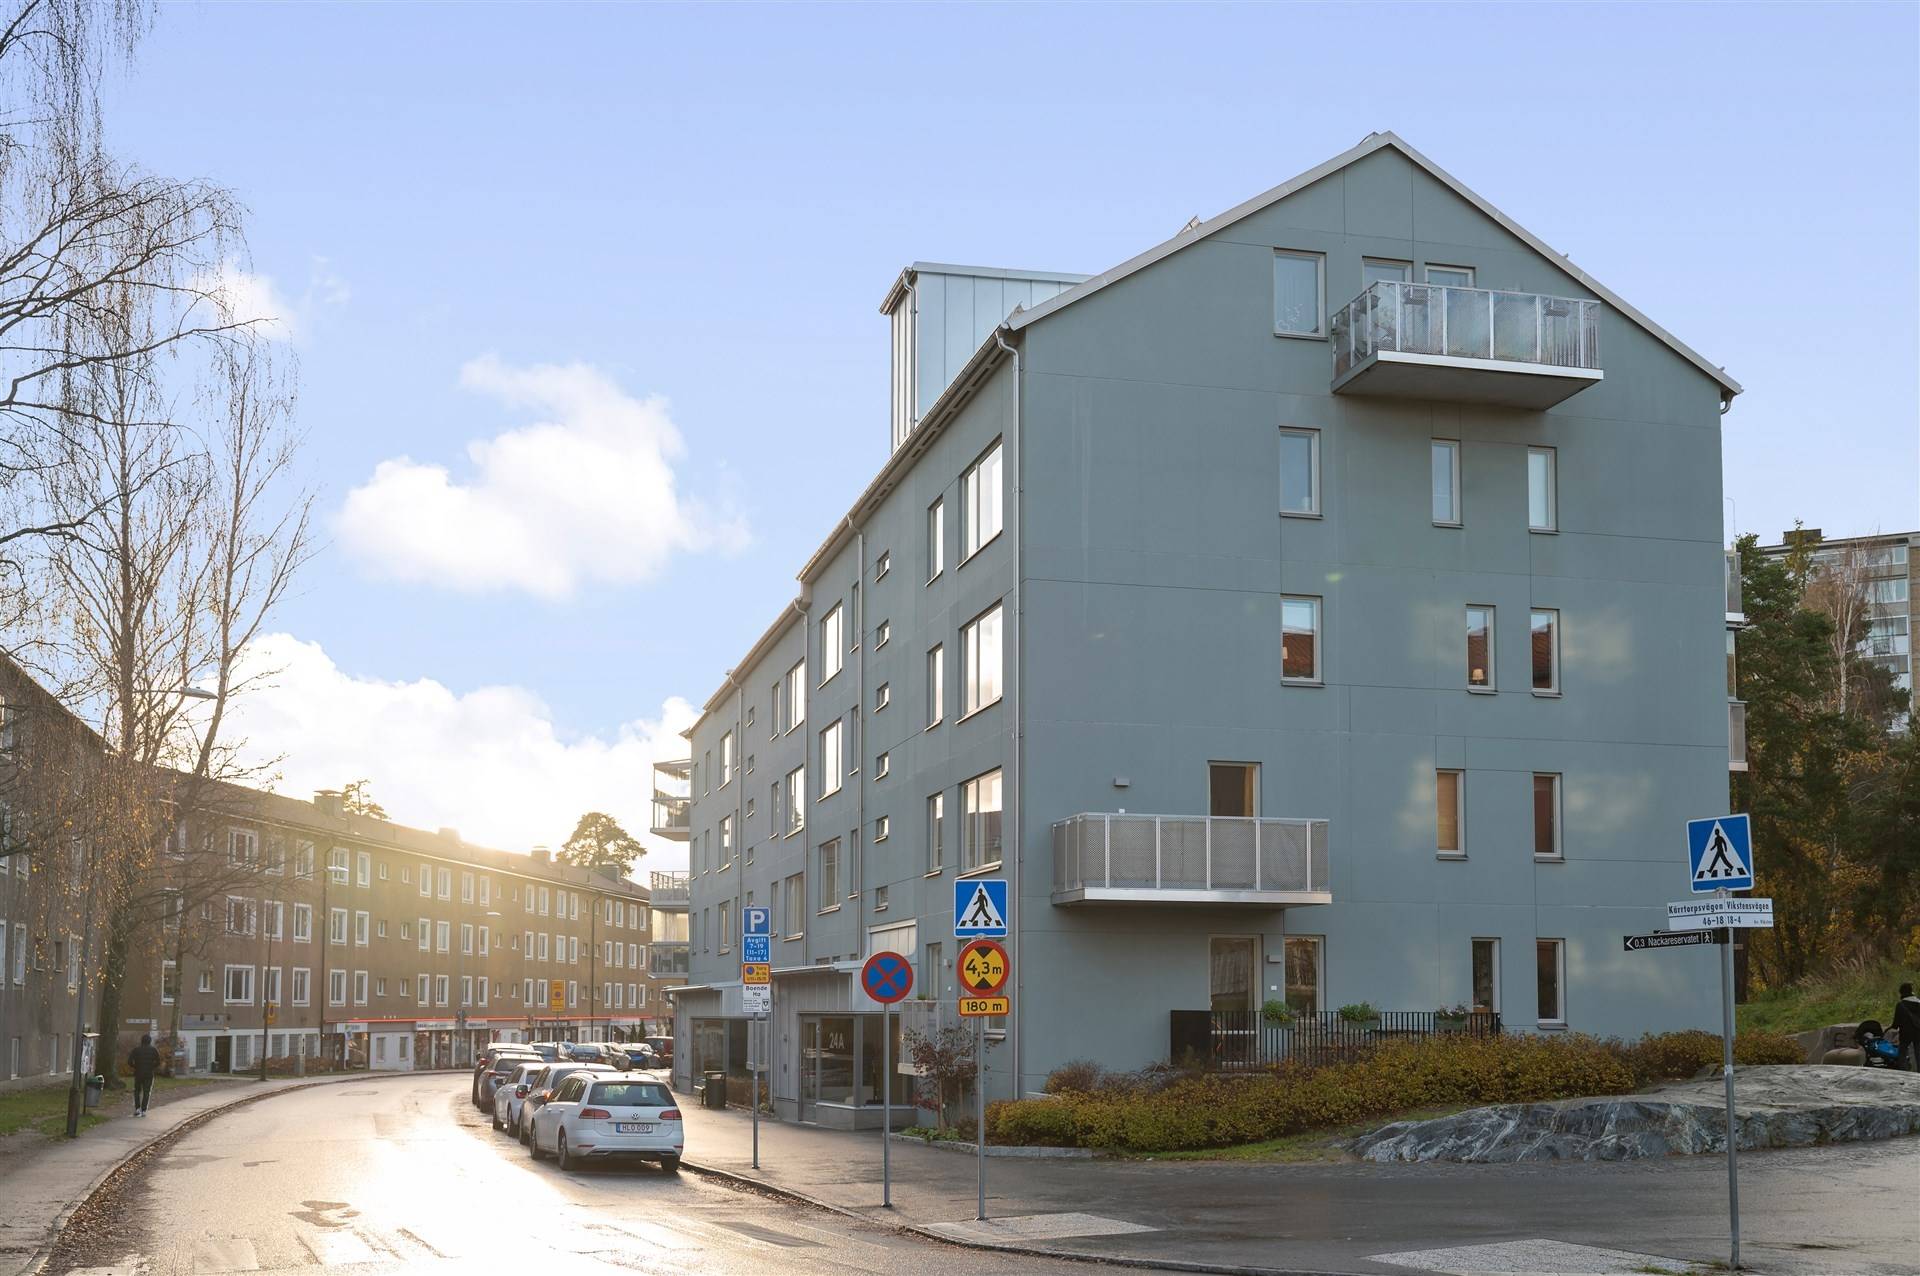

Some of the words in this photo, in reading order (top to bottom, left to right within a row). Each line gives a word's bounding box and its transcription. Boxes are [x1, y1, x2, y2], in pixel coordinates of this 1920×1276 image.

[1726, 901, 1769, 912] Vikstensvägen
[750, 910, 765, 932] P
[1702, 915, 1724, 926] 46-18
[1727, 915, 1741, 925] 18-4
[1648, 934, 1699, 947] Nackareservatet
[965, 958, 990, 977] 4,3
[992, 966, 1002, 974] m
[966, 1001, 988, 1012] 180
[992, 1003, 1002, 1011] m
